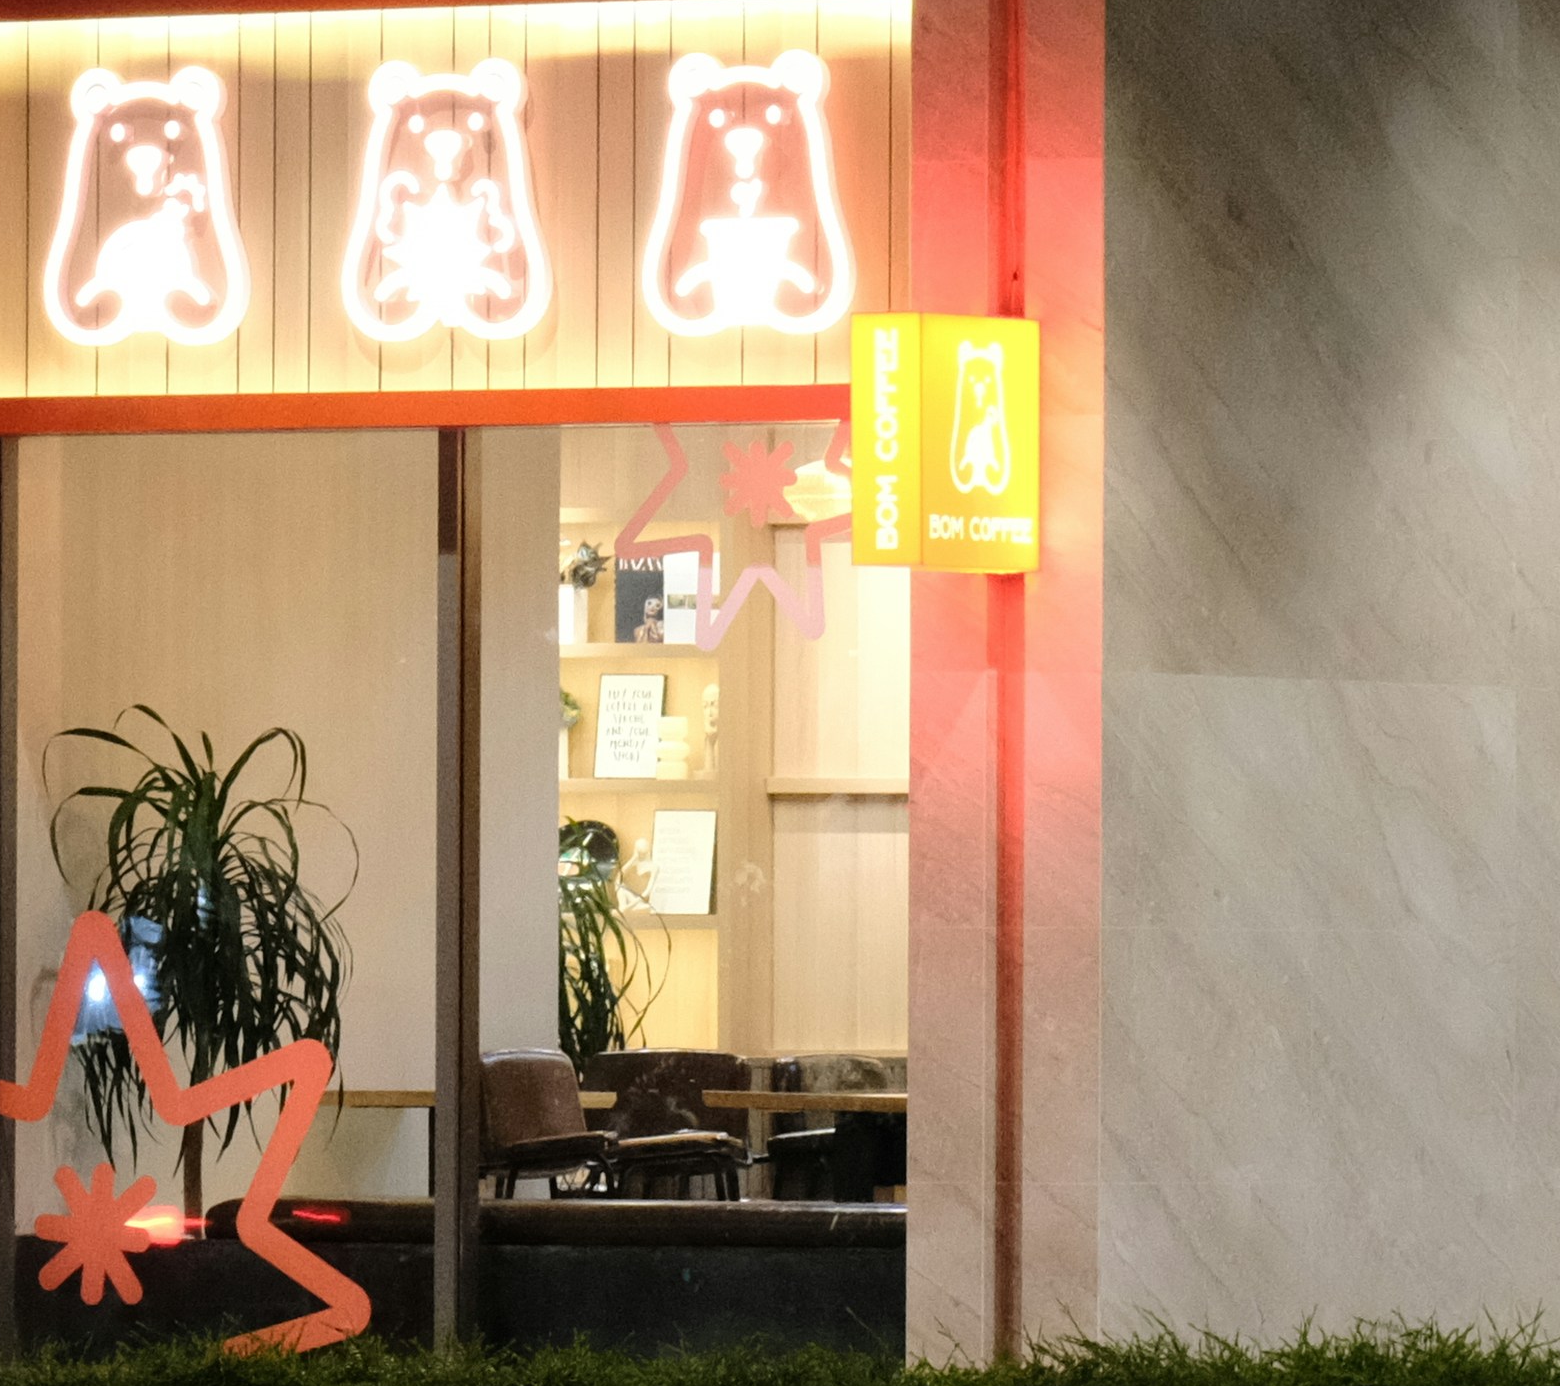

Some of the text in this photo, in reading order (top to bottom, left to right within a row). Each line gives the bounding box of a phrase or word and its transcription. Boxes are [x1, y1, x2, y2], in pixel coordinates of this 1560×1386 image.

[874, 327, 899, 550] BOM COFFEE
[929, 514, 1033, 544] BOM COFFEE
